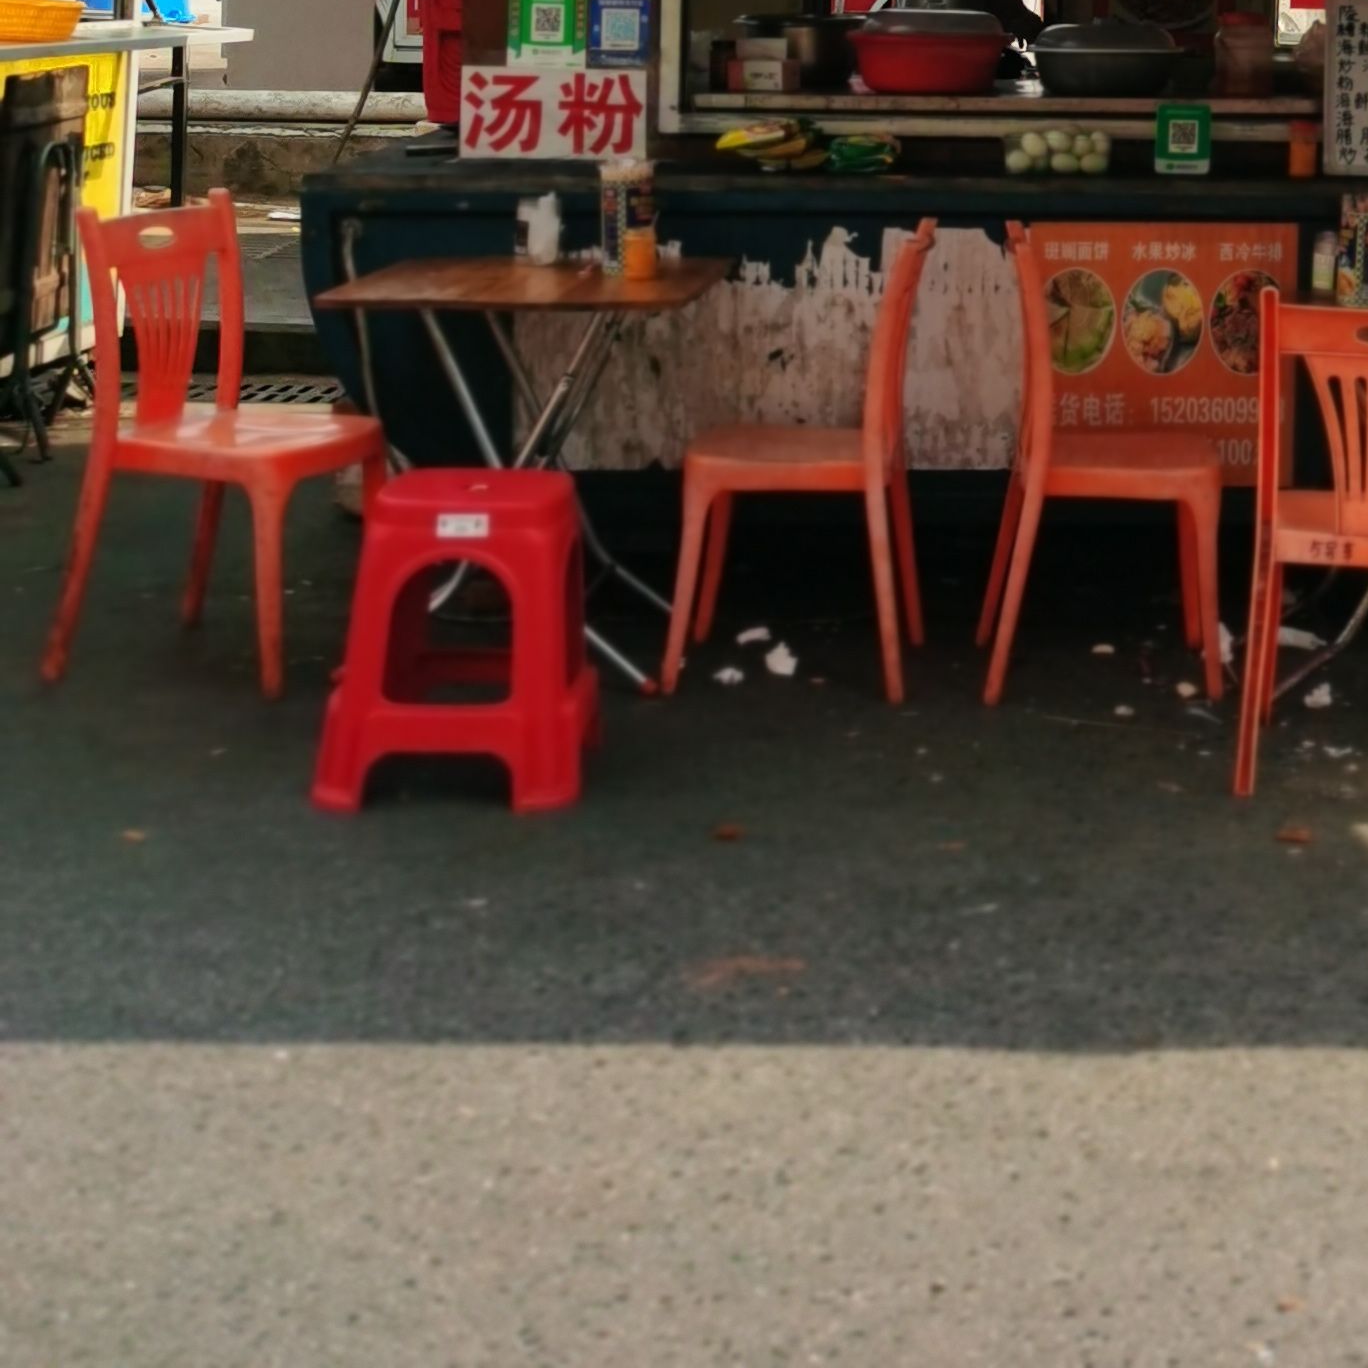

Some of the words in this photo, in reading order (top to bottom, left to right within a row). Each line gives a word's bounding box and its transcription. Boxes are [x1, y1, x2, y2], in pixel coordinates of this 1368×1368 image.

[464, 72, 643, 155] 汤粉
[1131, 241, 1197, 262] 水果炒冰
[1218, 242, 1283, 263] 西冷牛排
